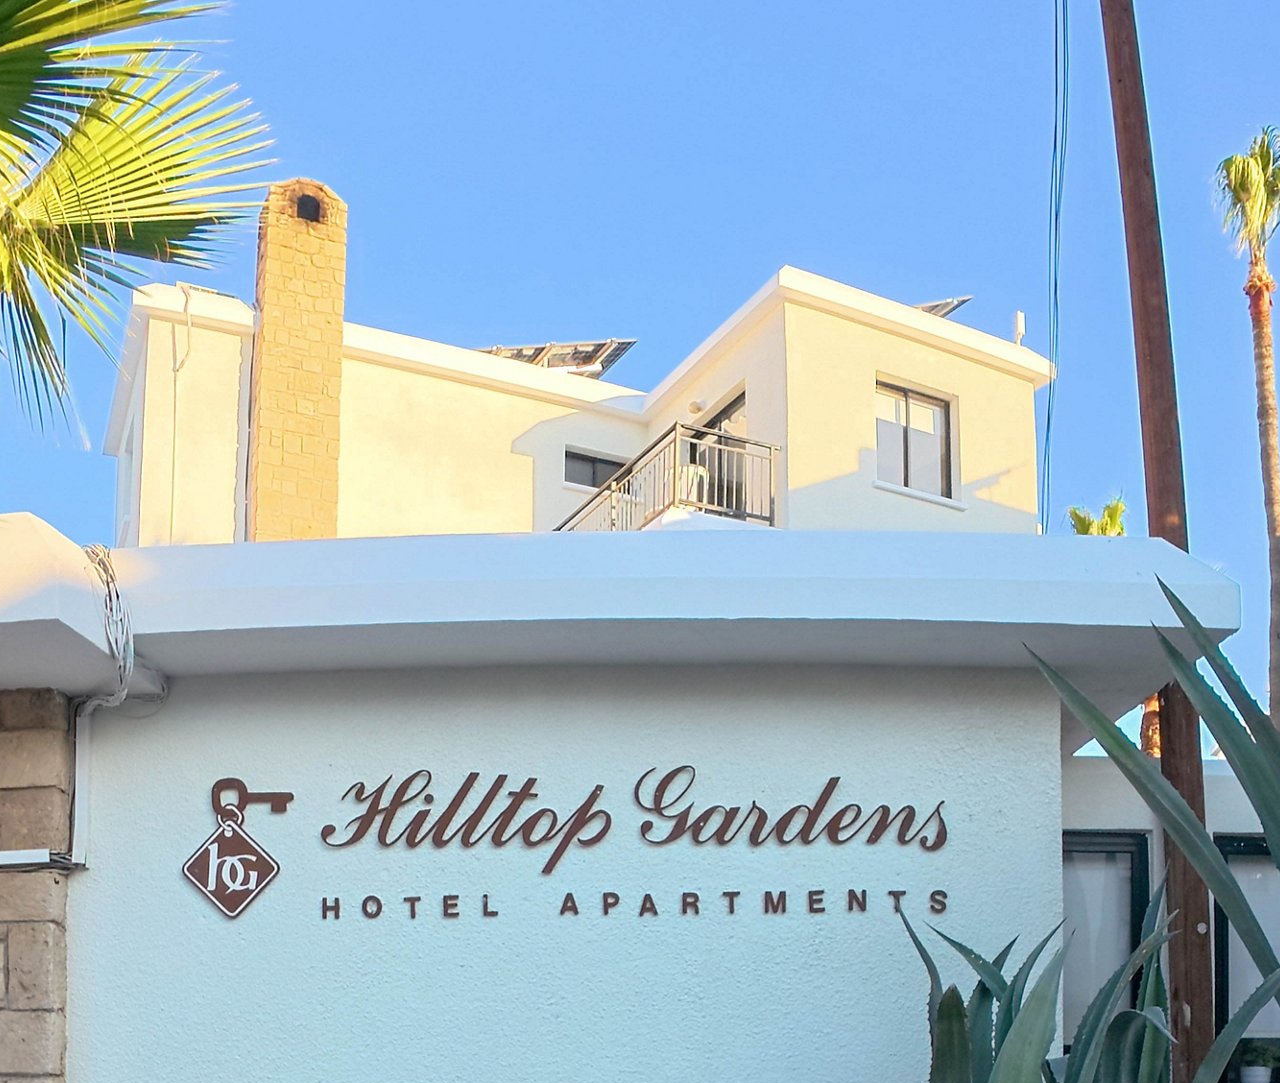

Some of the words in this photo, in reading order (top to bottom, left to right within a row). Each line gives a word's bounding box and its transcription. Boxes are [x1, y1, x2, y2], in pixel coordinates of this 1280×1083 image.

[320, 768, 612, 876] Hilltop
[634, 765, 948, 851] Gardens
[321, 894, 499, 920] HOTEL
[559, 889, 949, 918] APARTMENTS
